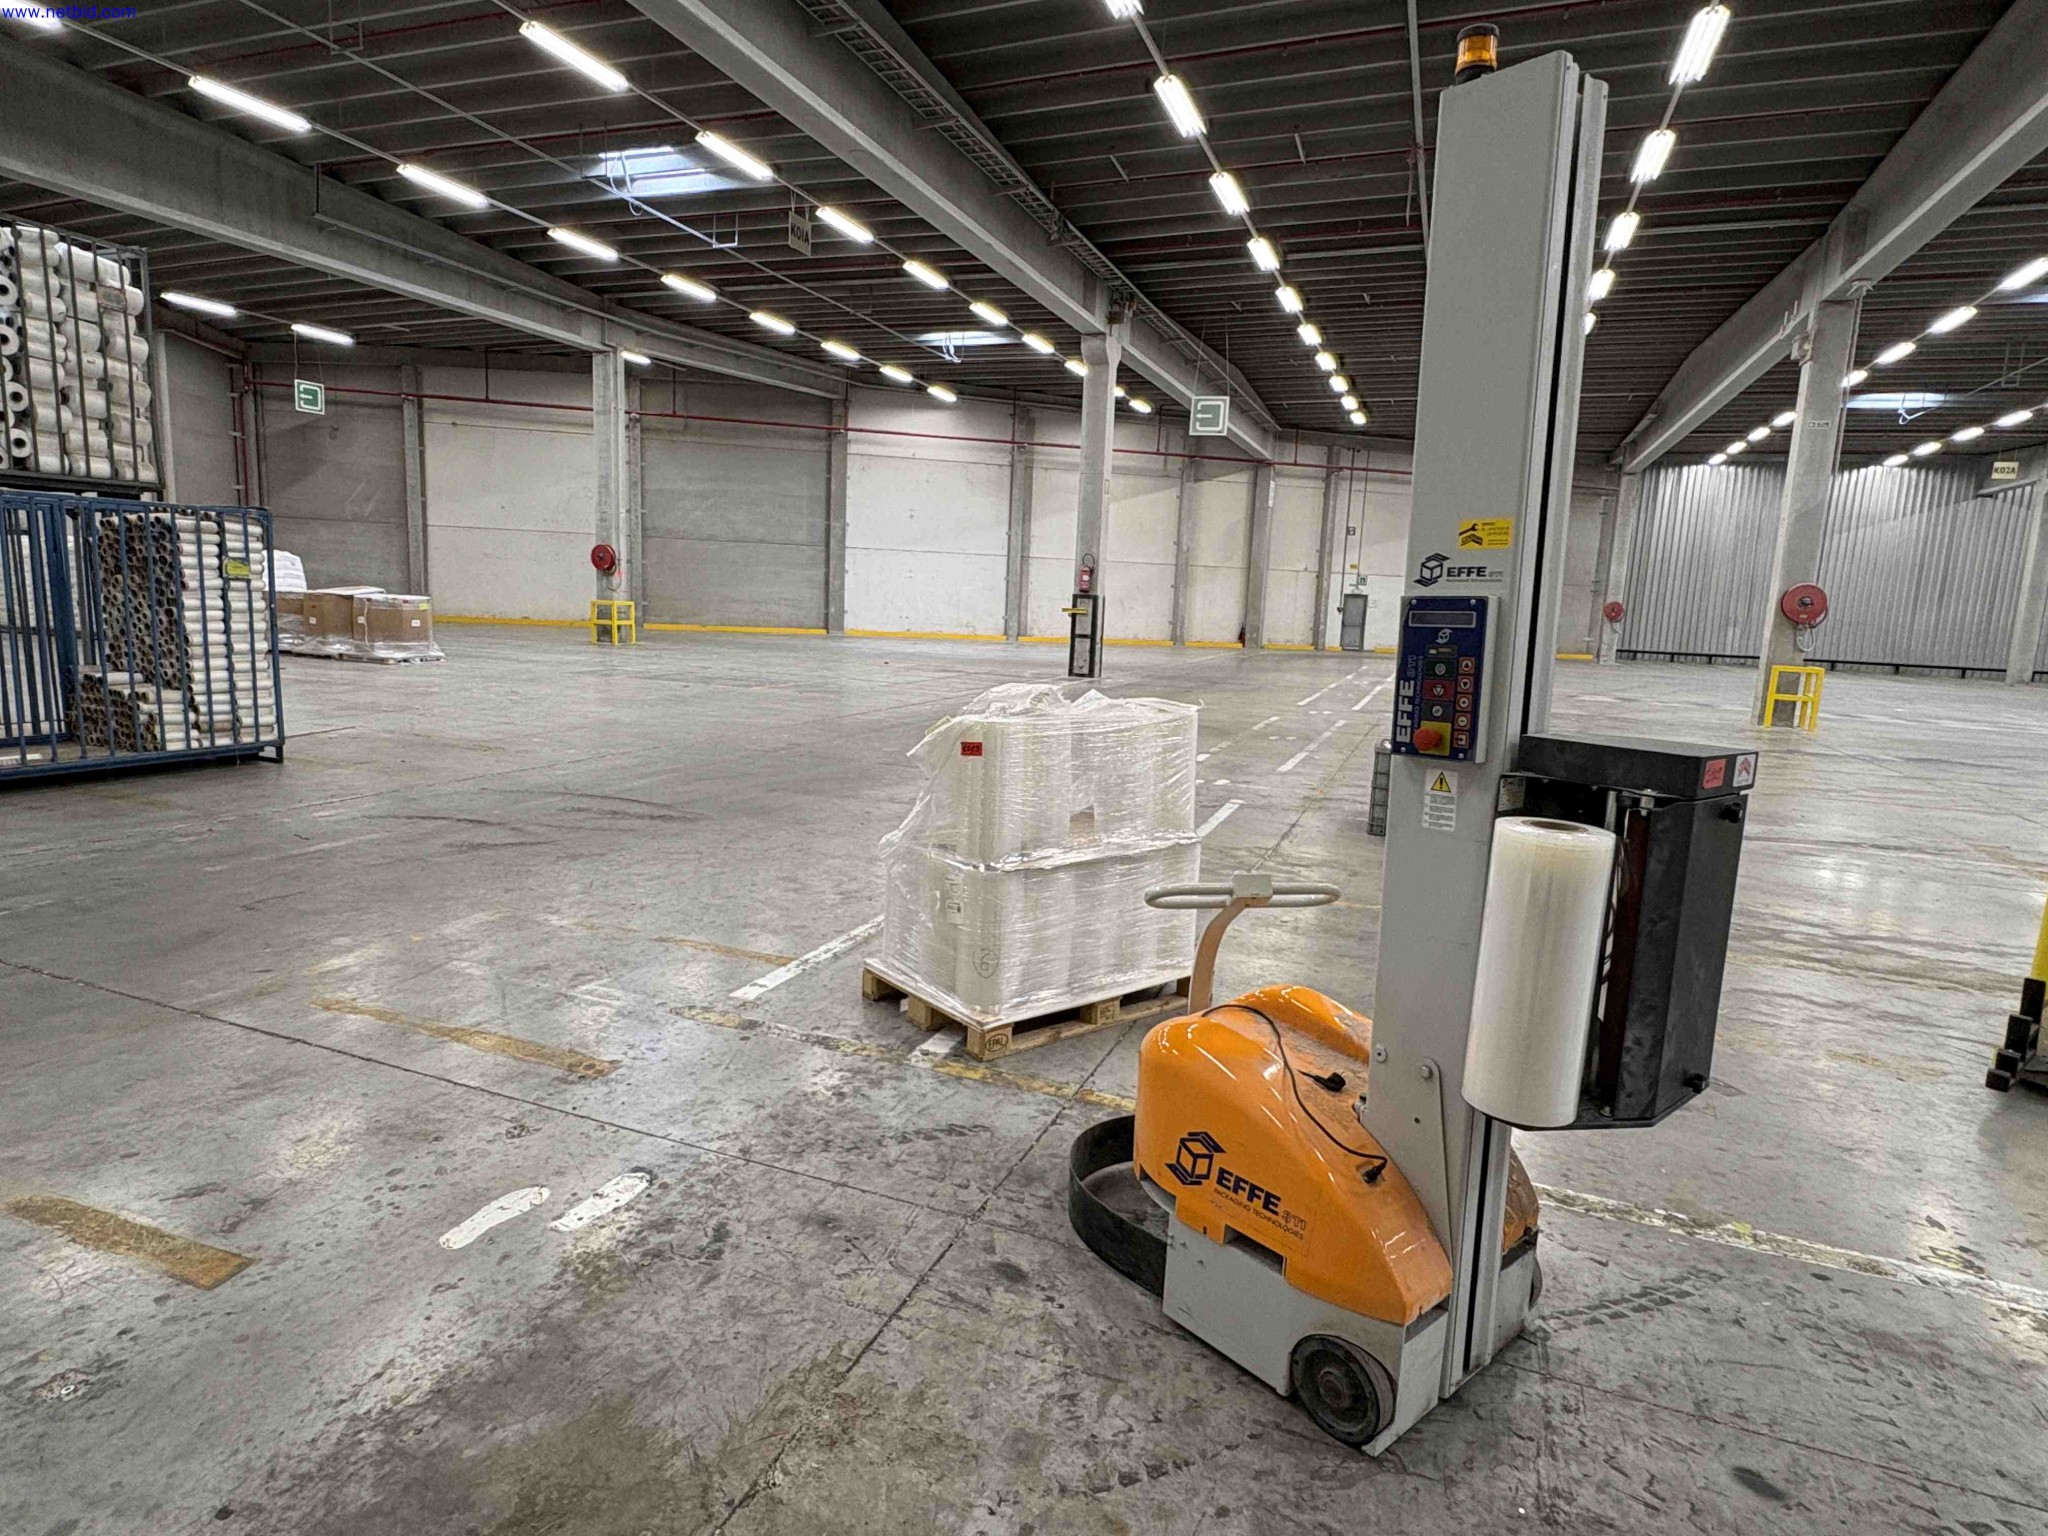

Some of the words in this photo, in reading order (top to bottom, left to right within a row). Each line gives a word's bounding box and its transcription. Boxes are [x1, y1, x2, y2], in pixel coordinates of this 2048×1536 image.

[1446, 566, 1488, 578] EFFE
[1395, 680, 1415, 743] EFFE
[1213, 1187, 1252, 1212] PACKAGING
[1252, 1208, 1304, 1240] TECHNOLOGIES
[1216, 1166, 1282, 1217] EFFE
